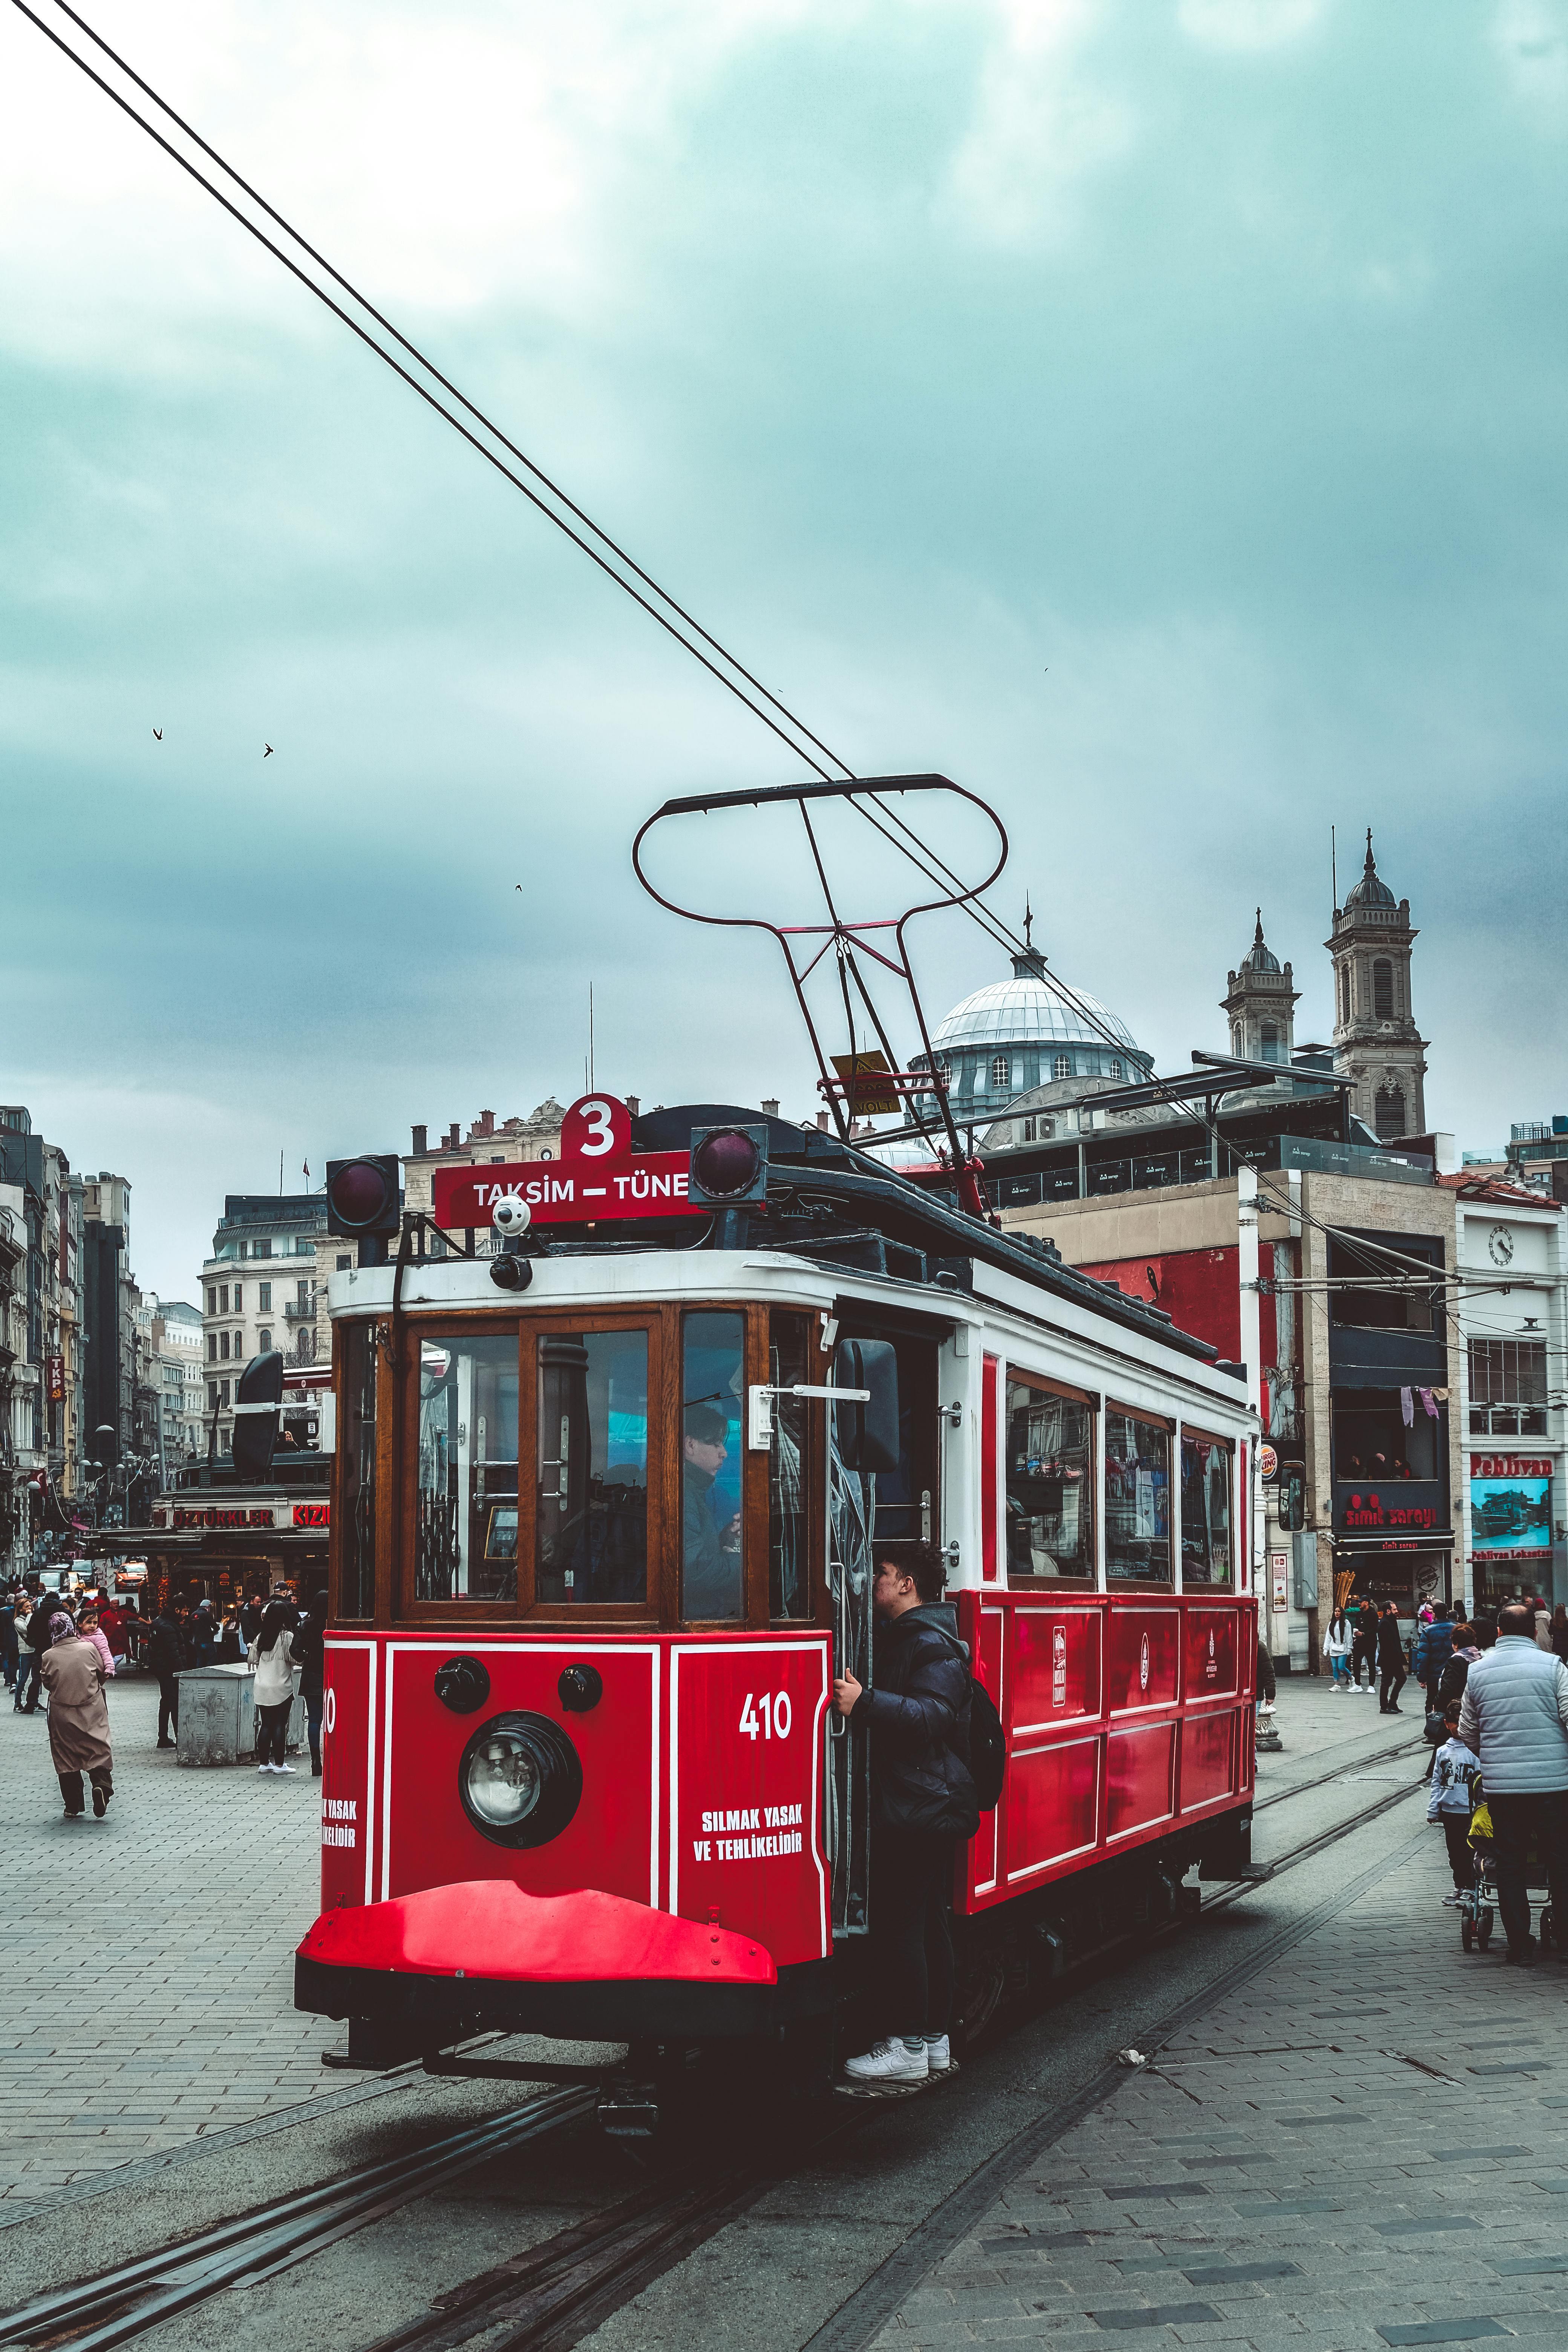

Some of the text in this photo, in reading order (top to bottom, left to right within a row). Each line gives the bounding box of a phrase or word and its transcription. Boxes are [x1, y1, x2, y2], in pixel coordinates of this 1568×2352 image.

[856, 1100, 892, 1113] VOLT
[579, 1101, 614, 1156] 3
[473, 1174, 574, 1206] TAKSİM
[613, 1169, 689, 1199] TÜNE
[52, 1359, 61, 1388] TKP
[1261, 1452, 1275, 1460] URGER
[1470, 1453, 1553, 1476] Pehlivan
[1347, 1494, 1437, 1528] simit sarayı
[1382, 1541, 1397, 1550] simit
[1472, 1550, 1509, 1560] Pehlivan
[323, 1688, 335, 1733] 10
[739, 1691, 792, 1740] 410
[328, 1799, 357, 1820] YASAK
[702, 1804, 802, 1832] SILMAK YASAK
[322, 1822, 355, 1848] İKELİDİR
[694, 1830, 802, 1861] VE TEHLİKELİDİR
